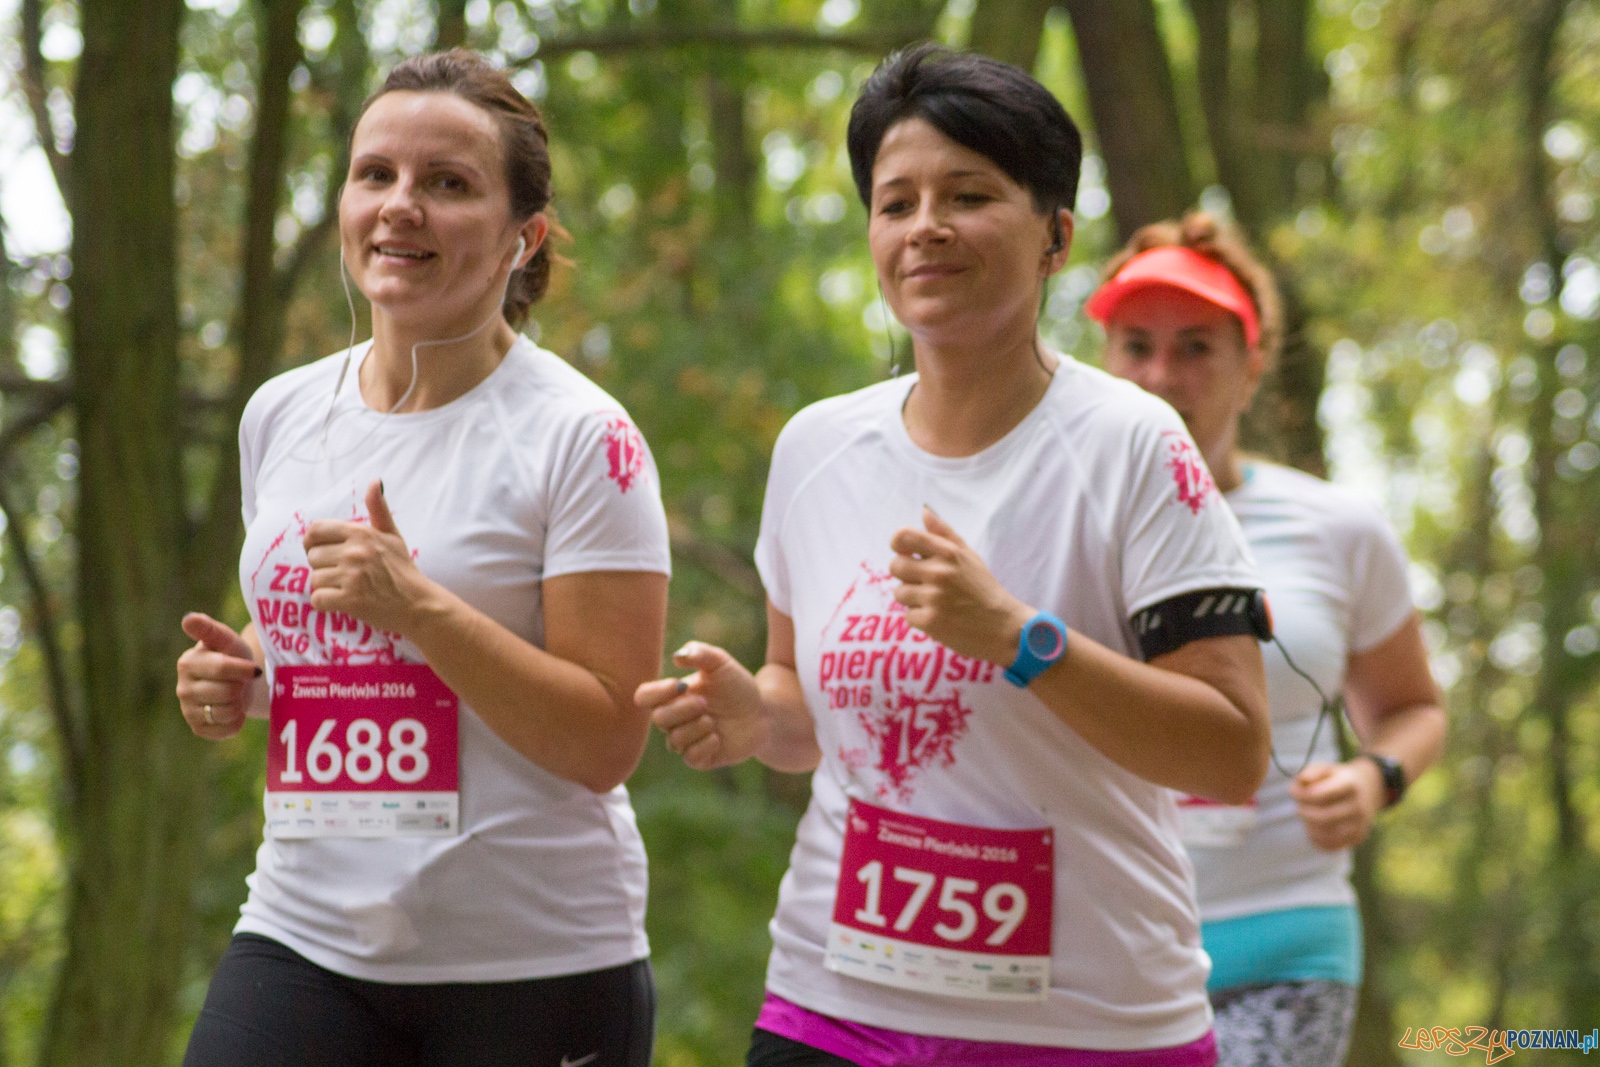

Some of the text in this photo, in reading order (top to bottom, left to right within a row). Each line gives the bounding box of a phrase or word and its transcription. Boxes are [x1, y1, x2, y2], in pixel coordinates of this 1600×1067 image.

[382, 682, 416, 698] 2016
[279, 718, 430, 784] 1688
[855, 860, 1029, 947] 1759
